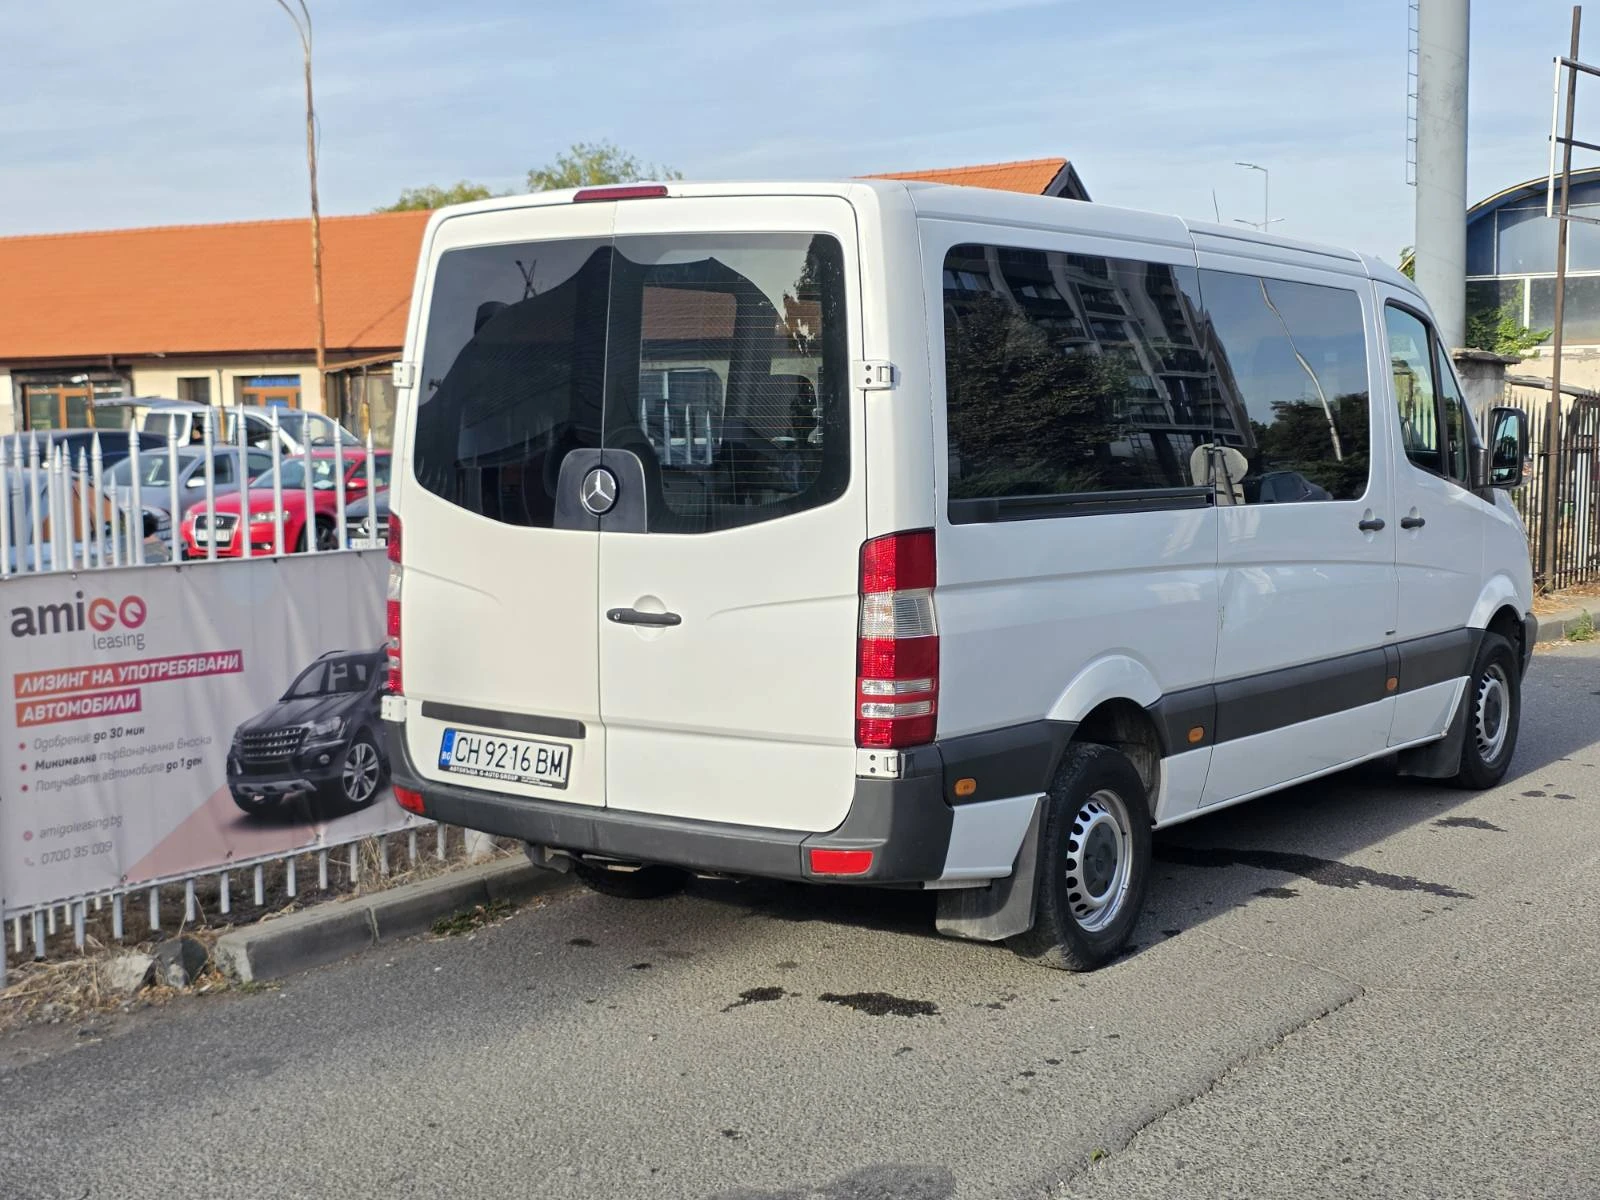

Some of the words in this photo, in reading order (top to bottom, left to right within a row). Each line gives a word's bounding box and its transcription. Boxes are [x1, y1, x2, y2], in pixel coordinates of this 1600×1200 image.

[93, 633, 146, 651] leasing
[19, 670, 89, 694] ЛИЗИНГ
[92, 669, 114, 684] НА
[118, 653, 240, 683] УПОТРЕБЯВАНИ
[21, 693, 137, 723] АВТОМОБИЛИ
[34, 734, 92, 753] Одобрение
[94, 731, 107, 744] до
[109, 727, 124, 739] 30
[125, 725, 145, 736] мин
[35, 754, 97, 771] Минимална
[166, 761, 179, 773] до
[180, 758, 185, 768] 1
[186, 758, 203, 770] ден
[455, 737, 481, 765] CH
[485, 741, 531, 772] 9216
[535, 747, 564, 777] BM
[41, 848, 71, 865] 0700
[73, 845, 89, 859] 35
[91, 840, 113, 855] 009
